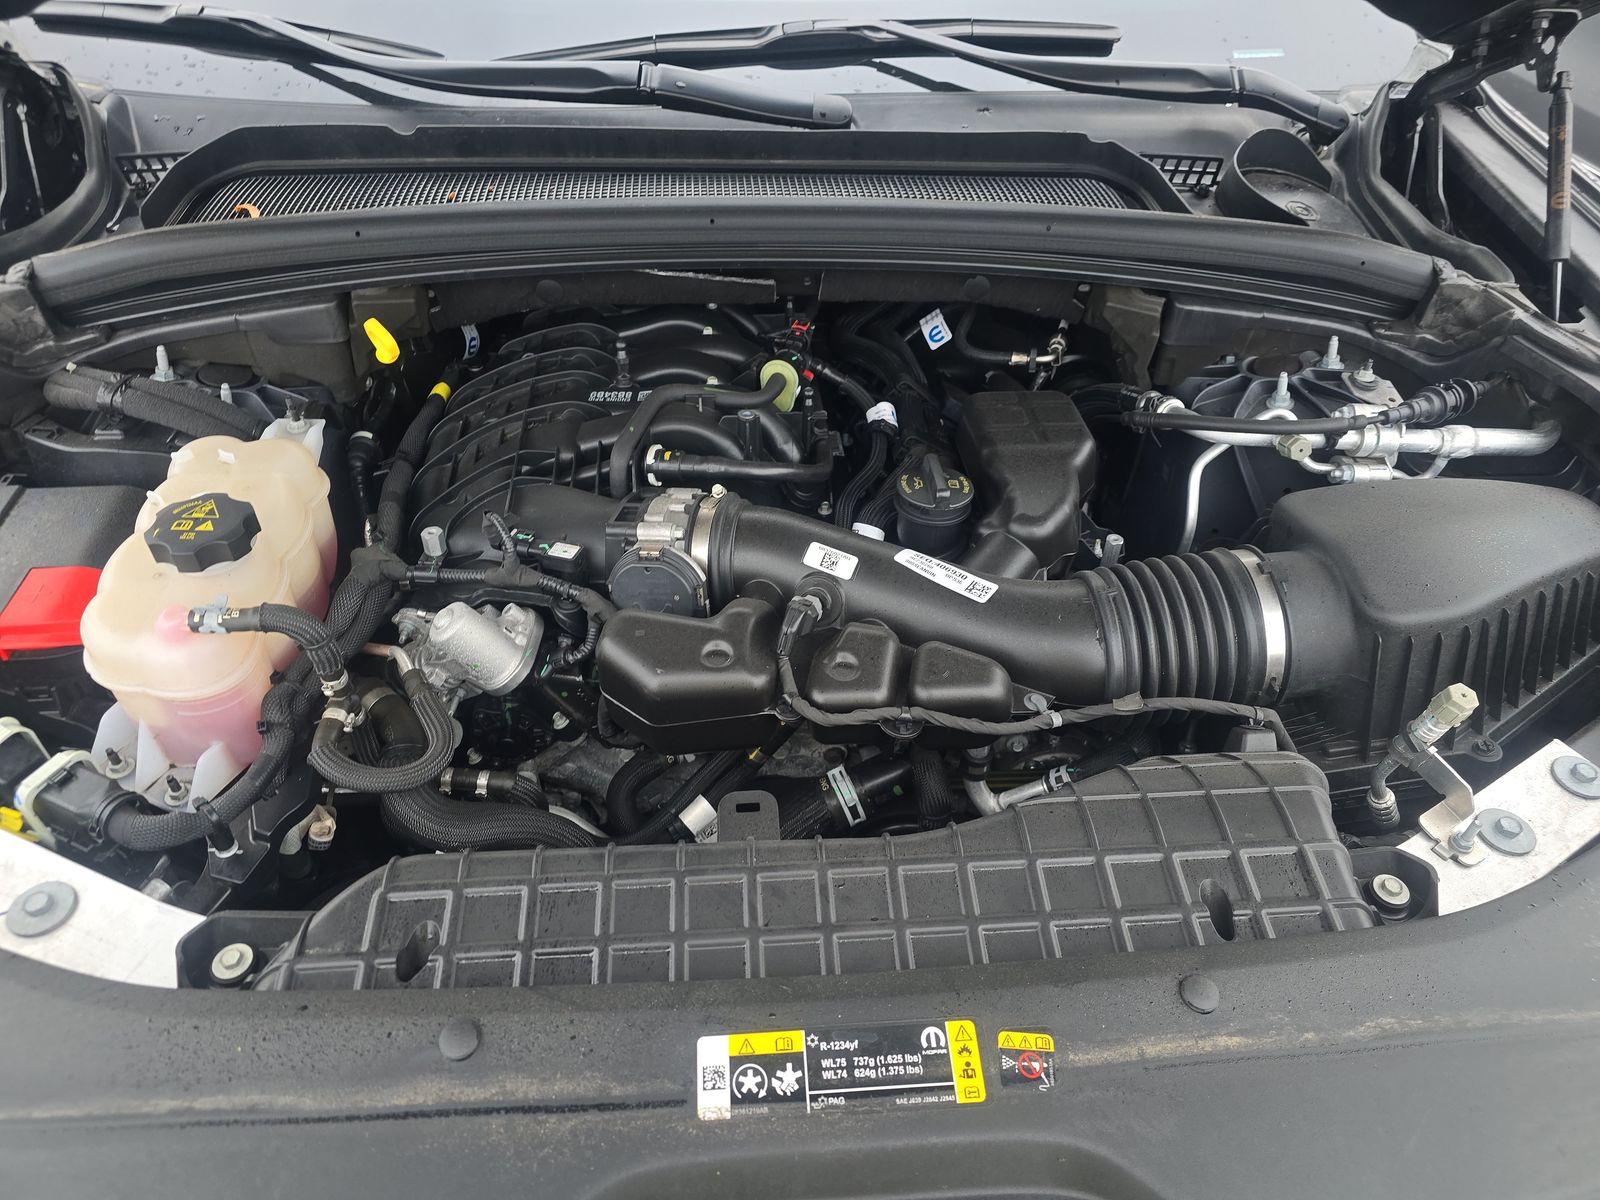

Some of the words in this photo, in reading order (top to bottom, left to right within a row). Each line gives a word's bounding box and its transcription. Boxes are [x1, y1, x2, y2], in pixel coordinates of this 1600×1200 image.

[820, 1040, 859, 1051] R-1234yf
[821, 1058, 847, 1068] WL75
[853, 1056, 875, 1067] 737g
[876, 1054, 903, 1067] (1.625
[904, 1053, 922, 1064] lbs)
[822, 1069, 848, 1080] WL74
[854, 1067, 877, 1079] 624g
[877, 1065, 905, 1078] (1.375
[905, 1064, 924, 1075] lbs)
[828, 1097, 846, 1106] PAG
